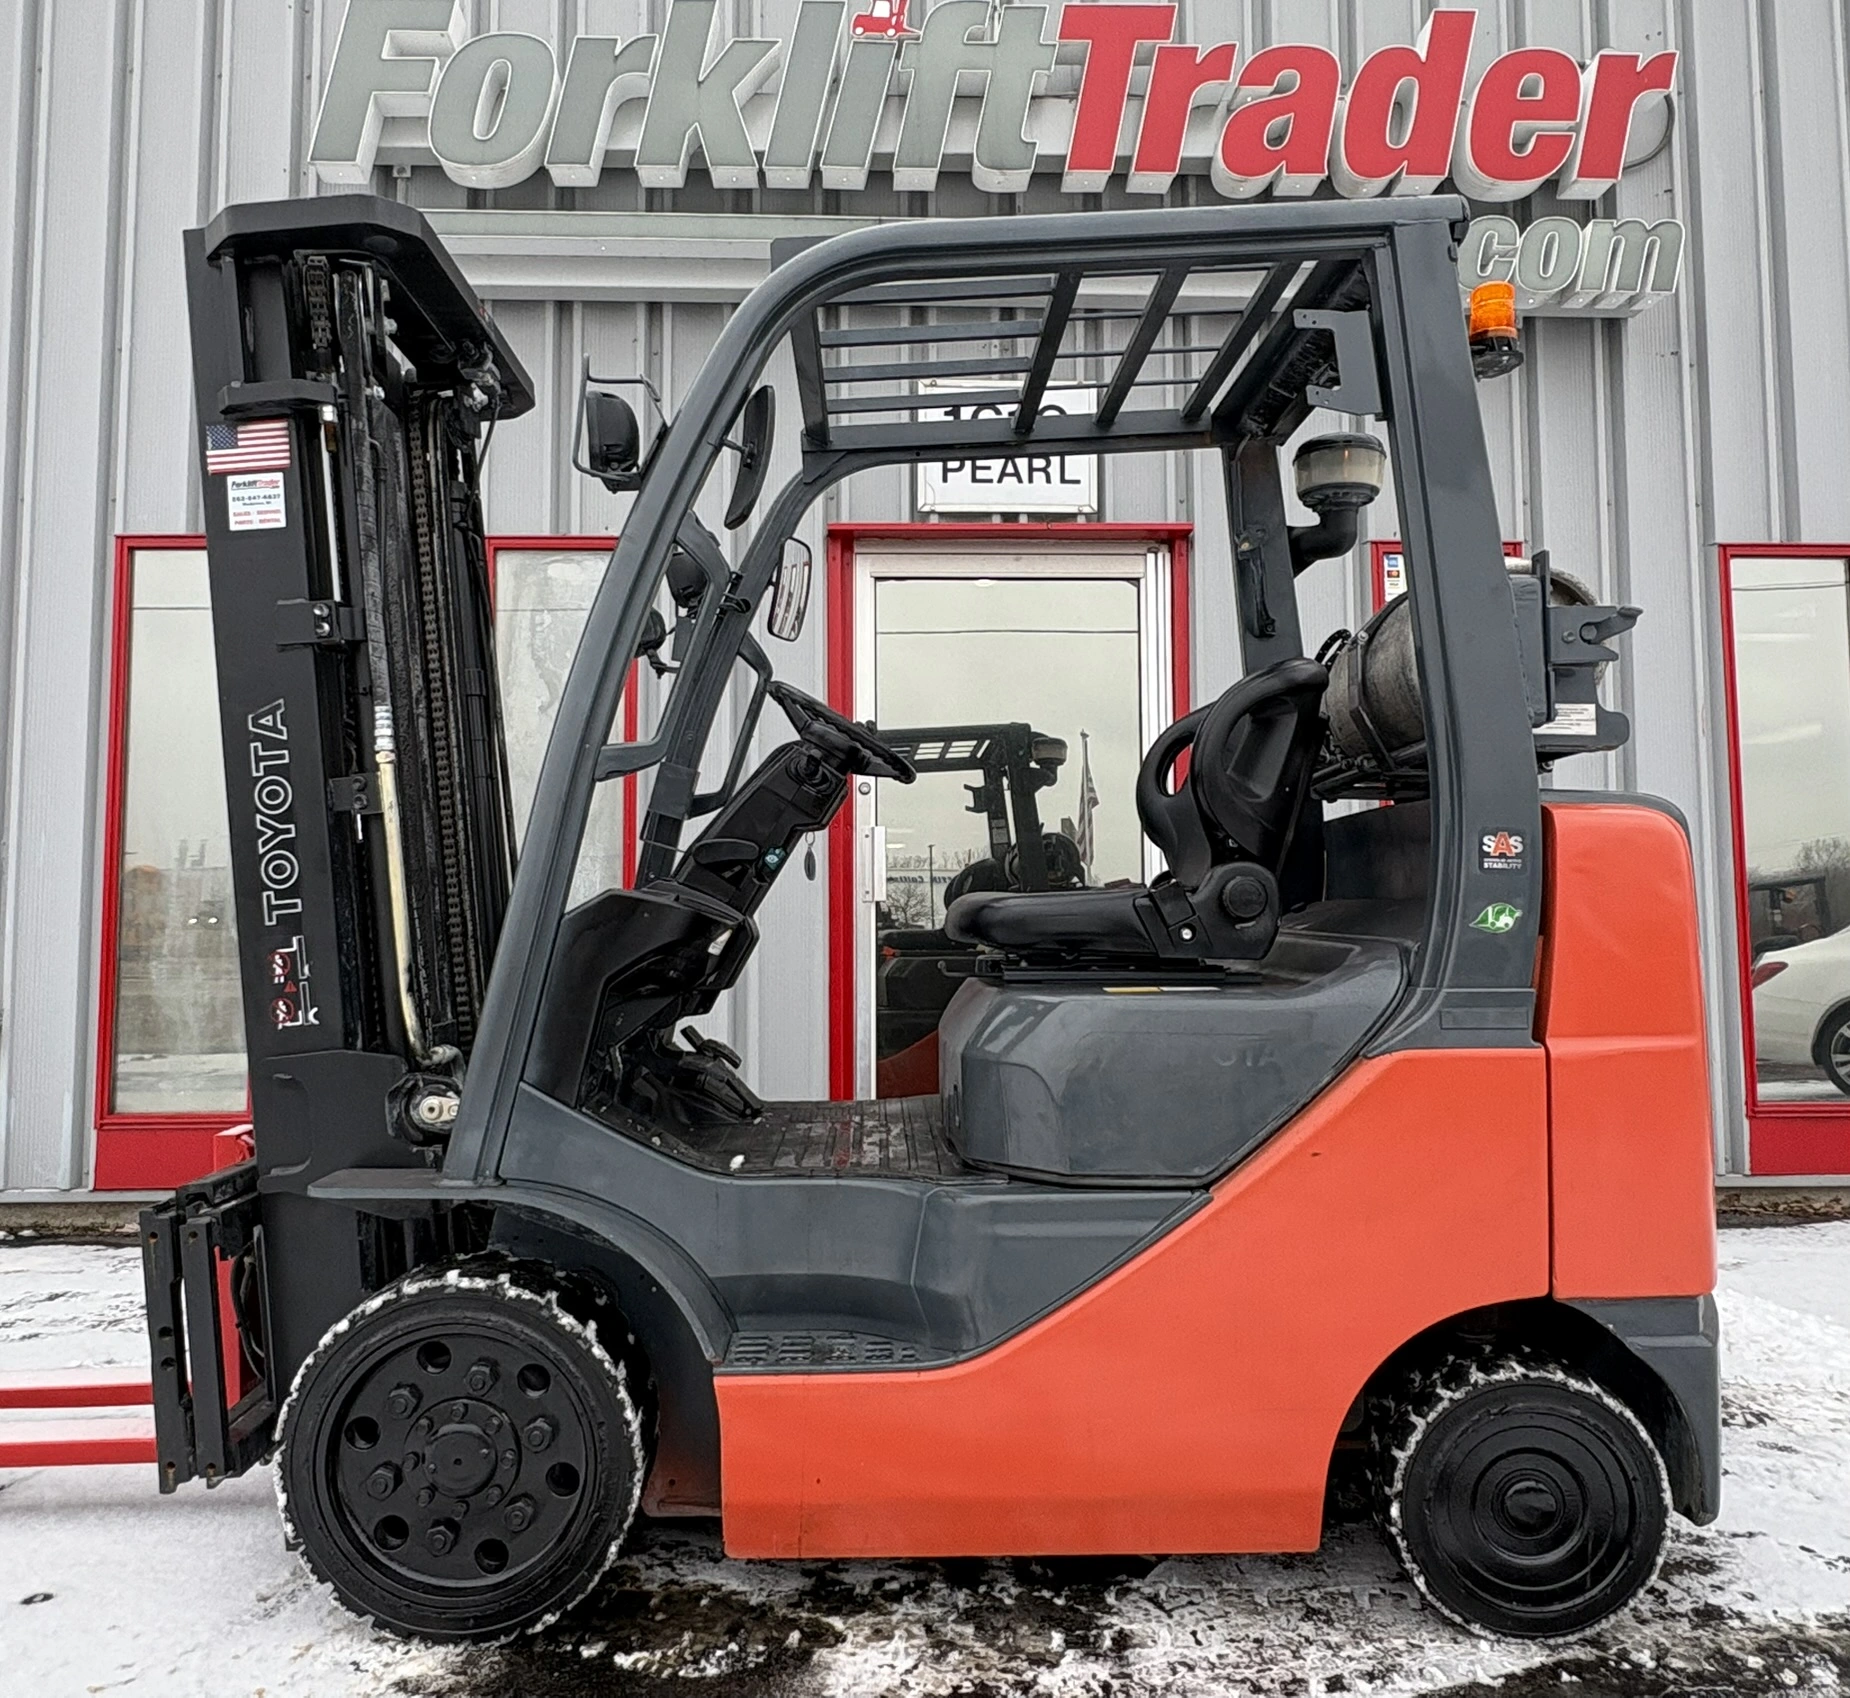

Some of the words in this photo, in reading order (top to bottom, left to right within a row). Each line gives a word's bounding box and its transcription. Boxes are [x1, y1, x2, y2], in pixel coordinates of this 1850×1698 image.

[942, 455, 1081, 484] PEARL
[249, 698, 302, 926] TOYOTA
[1481, 831, 1524, 856] SAS
